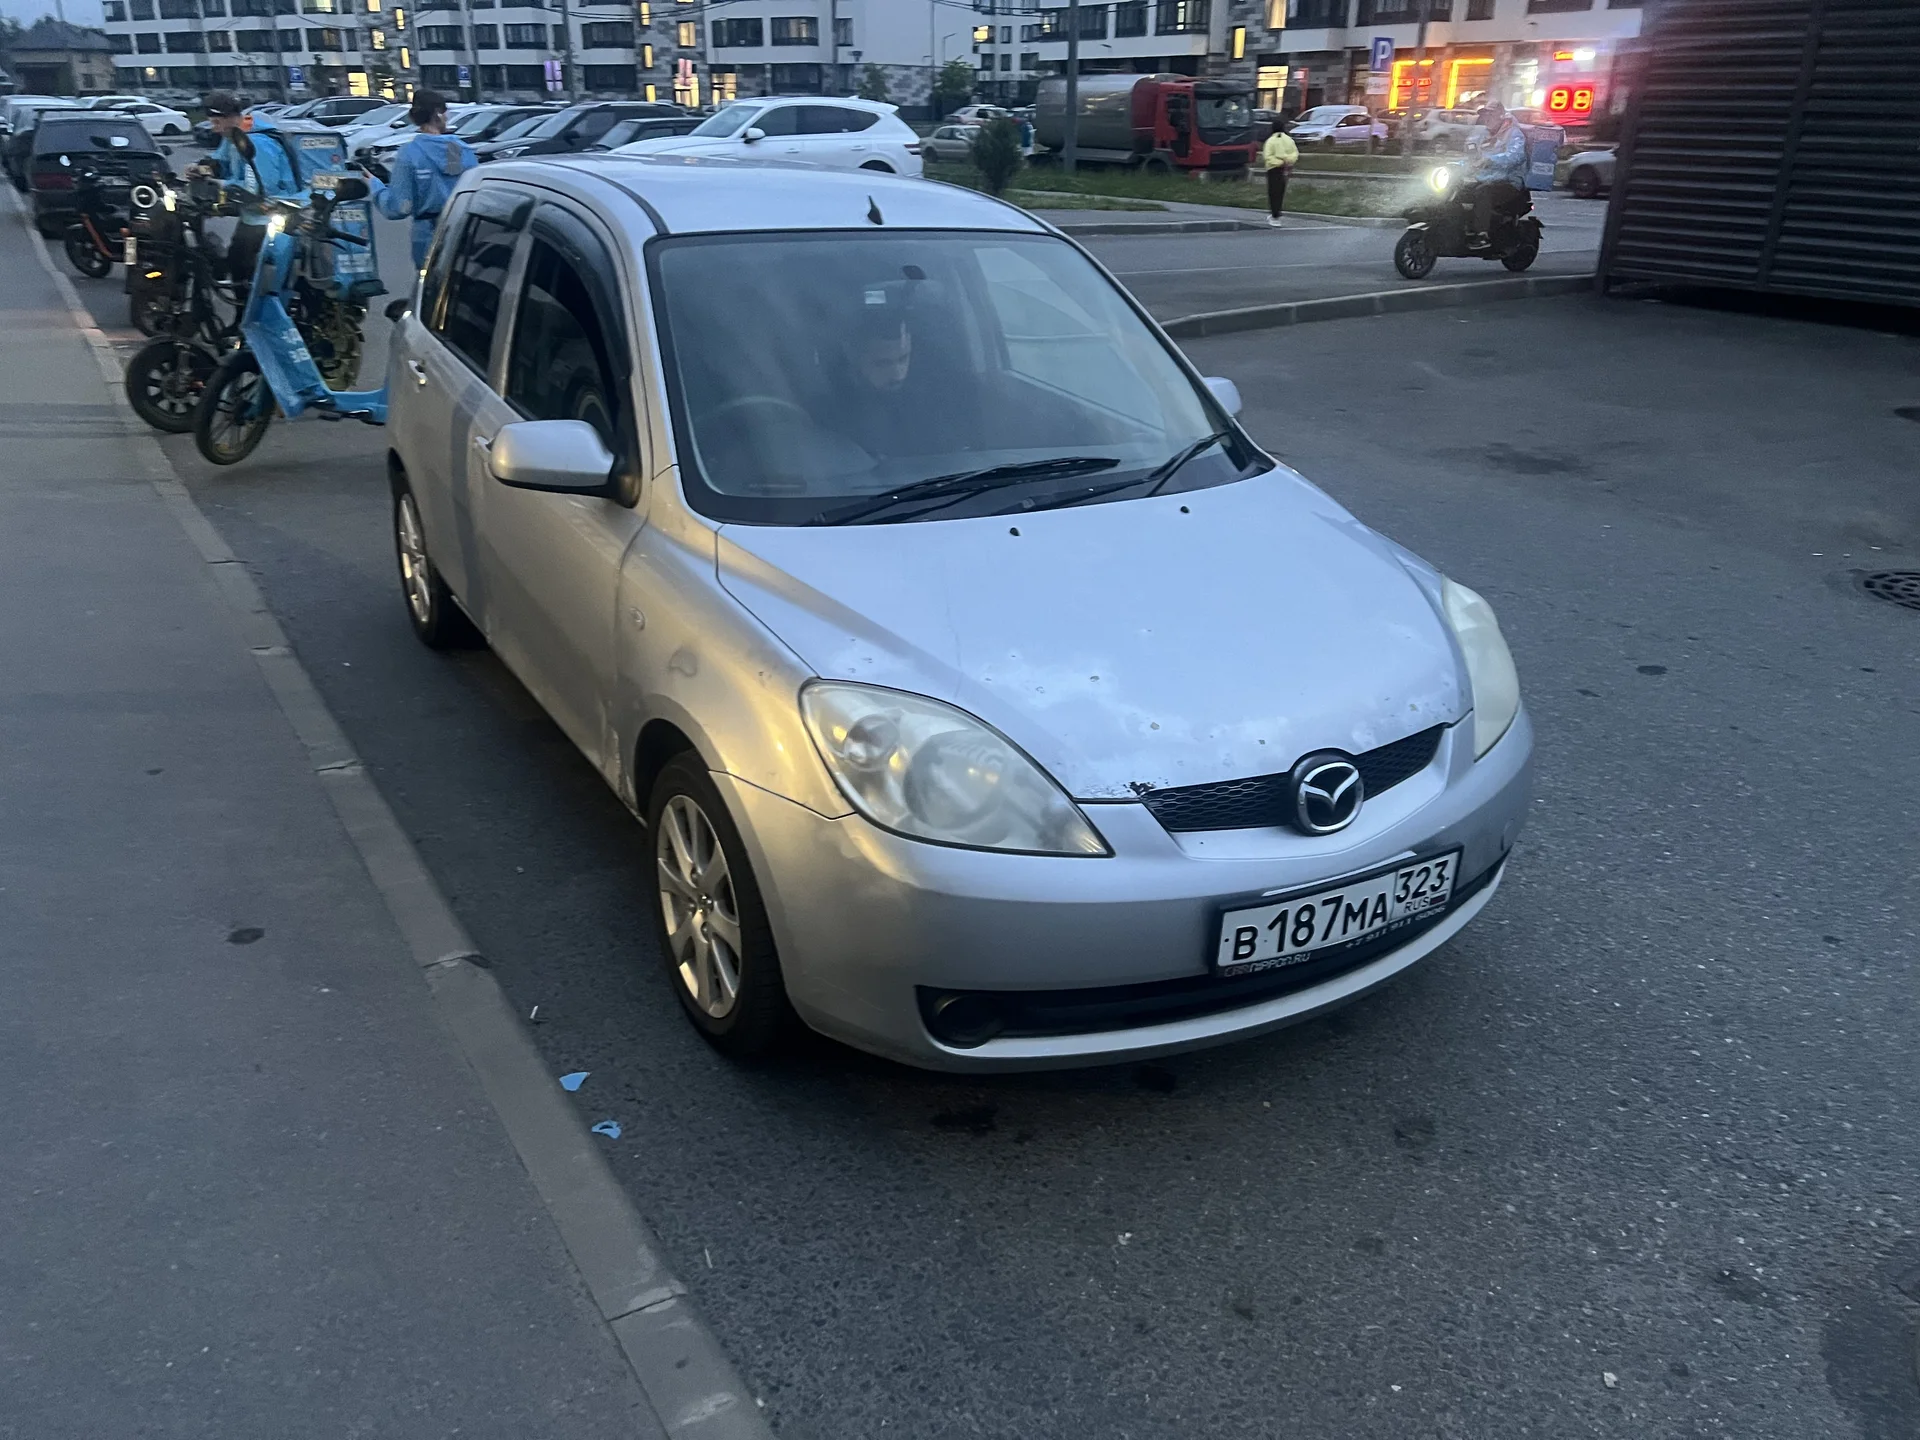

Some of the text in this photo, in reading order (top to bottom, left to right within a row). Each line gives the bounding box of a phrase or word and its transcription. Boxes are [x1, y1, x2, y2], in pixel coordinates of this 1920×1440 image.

[1375, 41, 1391, 69] P
[1396, 859, 1449, 903] 323
[1403, 897, 1429, 914] RUS
